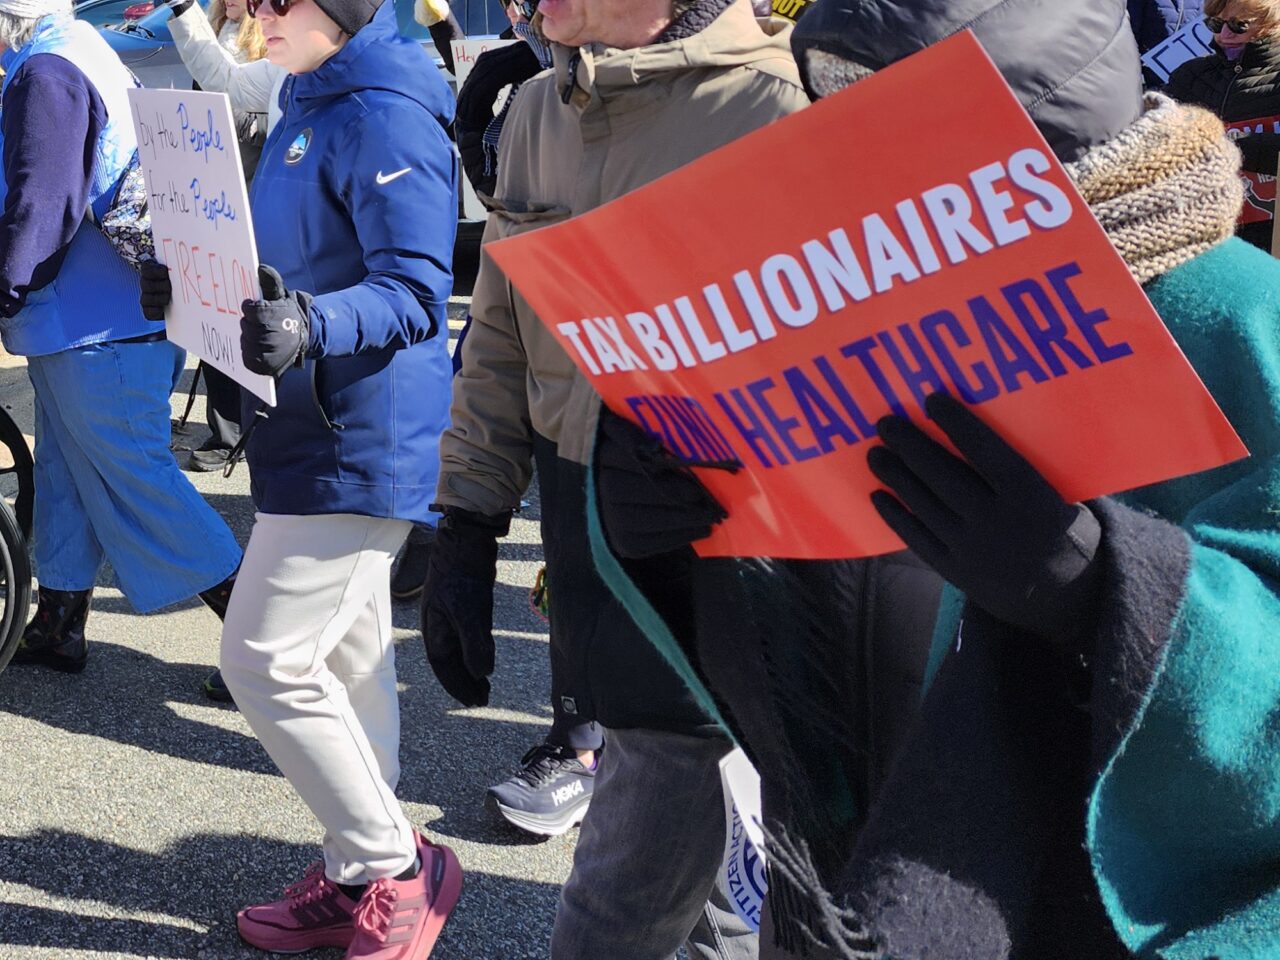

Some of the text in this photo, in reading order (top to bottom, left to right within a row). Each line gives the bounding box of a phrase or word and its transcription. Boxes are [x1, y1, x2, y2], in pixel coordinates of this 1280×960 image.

[136, 103, 157, 160] by
[156, 111, 178, 149] the
[168, 180, 190, 214] the
[162, 238, 257, 316] FIRE ELON
[557, 147, 1074, 376] TAX BILLIONAIRES
[201, 320, 235, 372] NOW!
[625, 260, 1133, 470] FUND HEALTHCARE
[551, 779, 585, 807] HOKA
